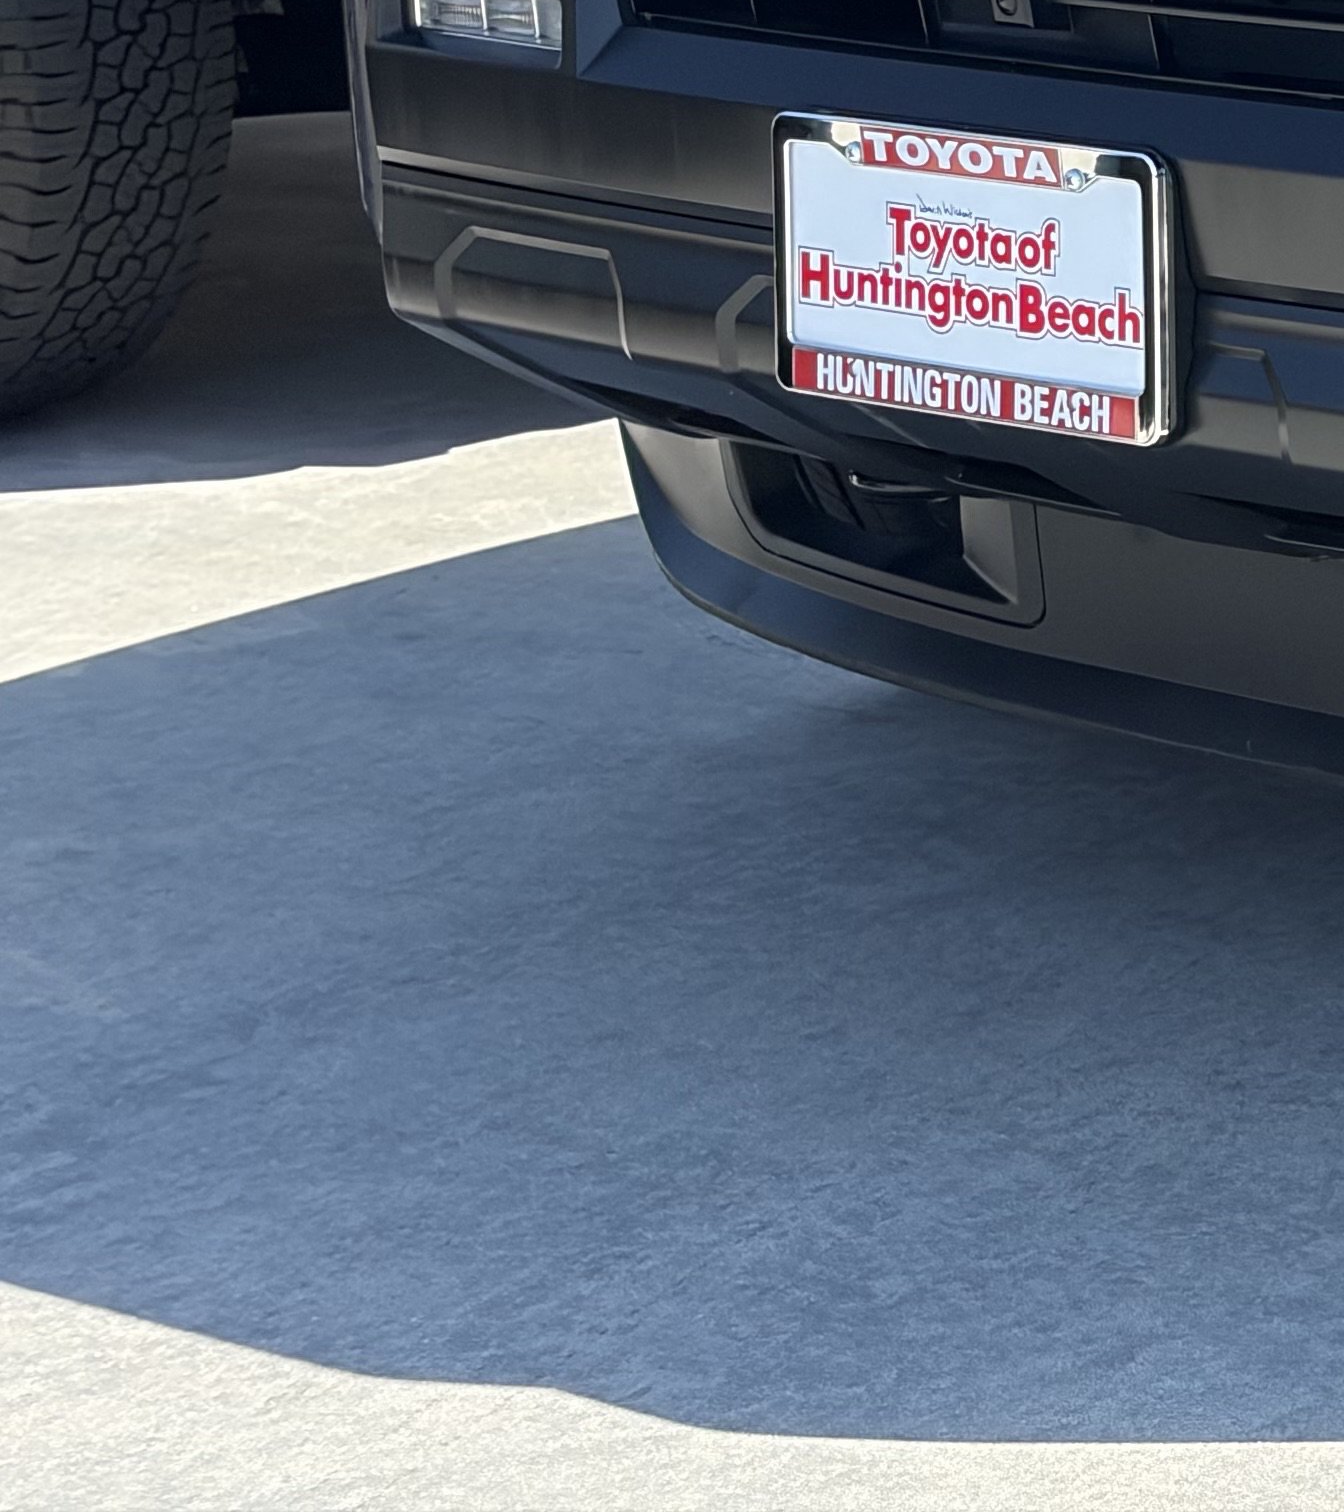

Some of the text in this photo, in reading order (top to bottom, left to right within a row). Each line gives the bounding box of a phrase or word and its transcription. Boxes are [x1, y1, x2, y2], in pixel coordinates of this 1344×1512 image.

[863, 130, 1057, 183] TOYOTA
[889, 207, 1057, 269] Toyota of
[800, 251, 1141, 344] Huntington Beach
[816, 353, 1110, 434] HUNTINGTON BEACH
